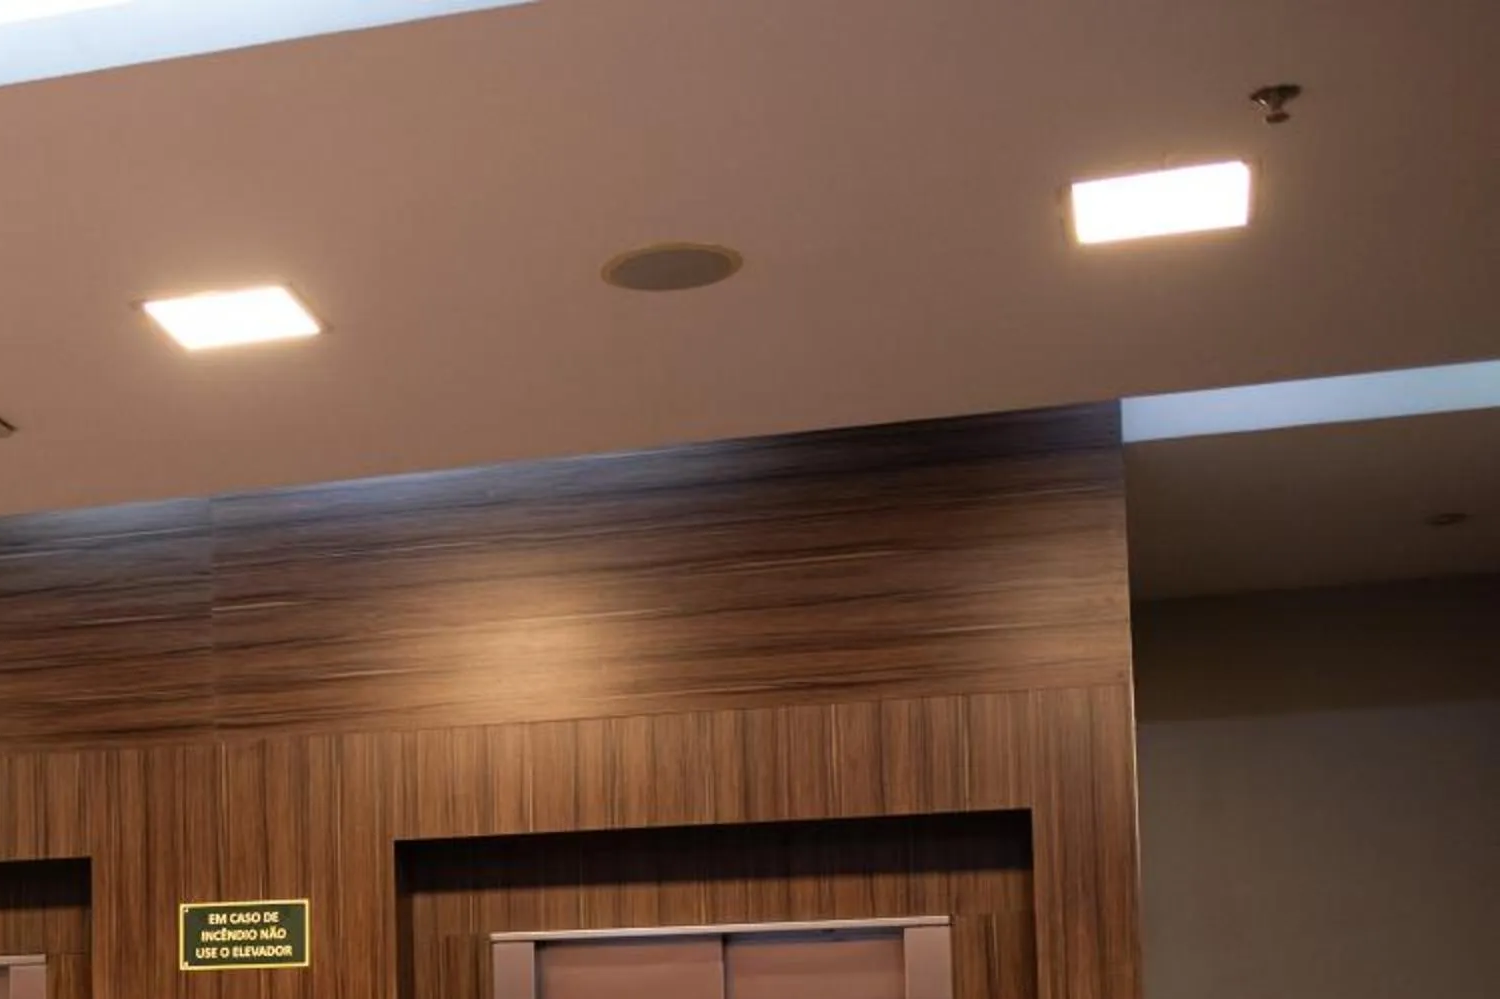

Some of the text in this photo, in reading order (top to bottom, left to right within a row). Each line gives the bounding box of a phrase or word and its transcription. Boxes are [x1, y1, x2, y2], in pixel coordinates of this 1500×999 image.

[208, 911, 279, 925] EM CASO DE
[201, 926, 287, 942] INCÊNDIO NÃO
[195, 945, 293, 959] USE O ELEVADOR
